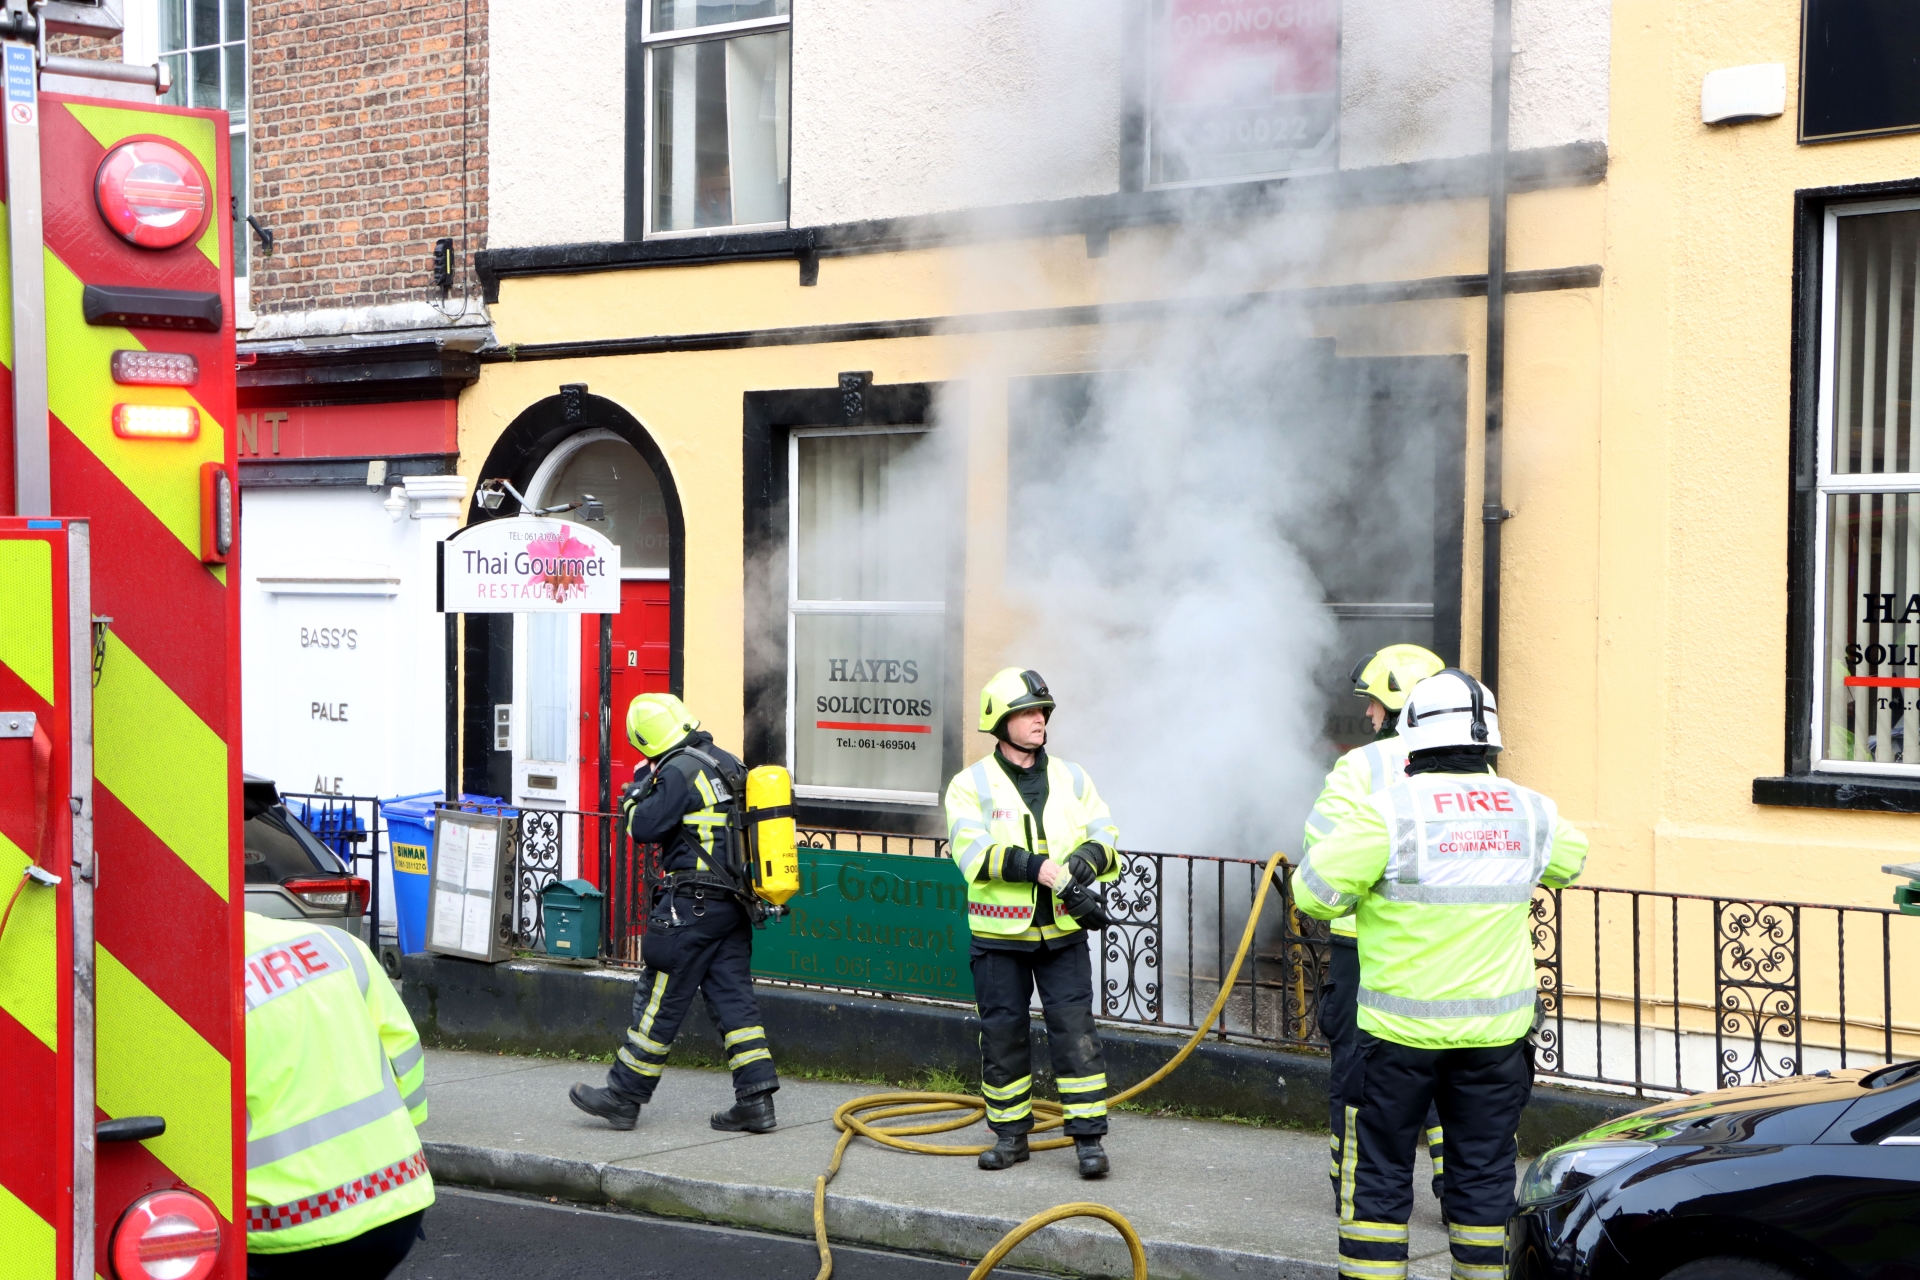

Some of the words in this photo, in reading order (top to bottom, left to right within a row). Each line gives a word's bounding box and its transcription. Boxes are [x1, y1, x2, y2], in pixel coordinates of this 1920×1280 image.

[9, 65, 31, 73] HAND
[10, 77, 31, 85] HOLD
[11, 89, 31, 97] HERE
[509, 532, 523, 541] TEL:
[525, 532, 538, 541] 061
[540, 533, 565, 542] 312012
[462, 550, 508, 574] Thai
[514, 552, 605, 577] Gourmet
[478, 583, 590, 600] RESTAURANT
[1862, 593, 1920, 623] HA
[301, 627, 358, 649] BASS'S
[630, 652, 635, 665] 2
[1845, 643, 1918, 666] SOLI
[829, 659, 919, 684] HAYES
[311, 702, 348, 722] PALE
[816, 696, 932, 717] SOLICITORS
[858, 739, 916, 750] 061-469504
[314, 774, 343, 796] ALE
[1433, 791, 1514, 813] FIRE
[1451, 830, 1509, 841] INCIDENT
[397, 845, 426, 861] BINMAN
[1439, 841, 1521, 853] COMMANDER
[788, 907, 956, 957] Restaurant
[788, 950, 825, 973] Tel.
[835, 955, 958, 988] 061-312012
